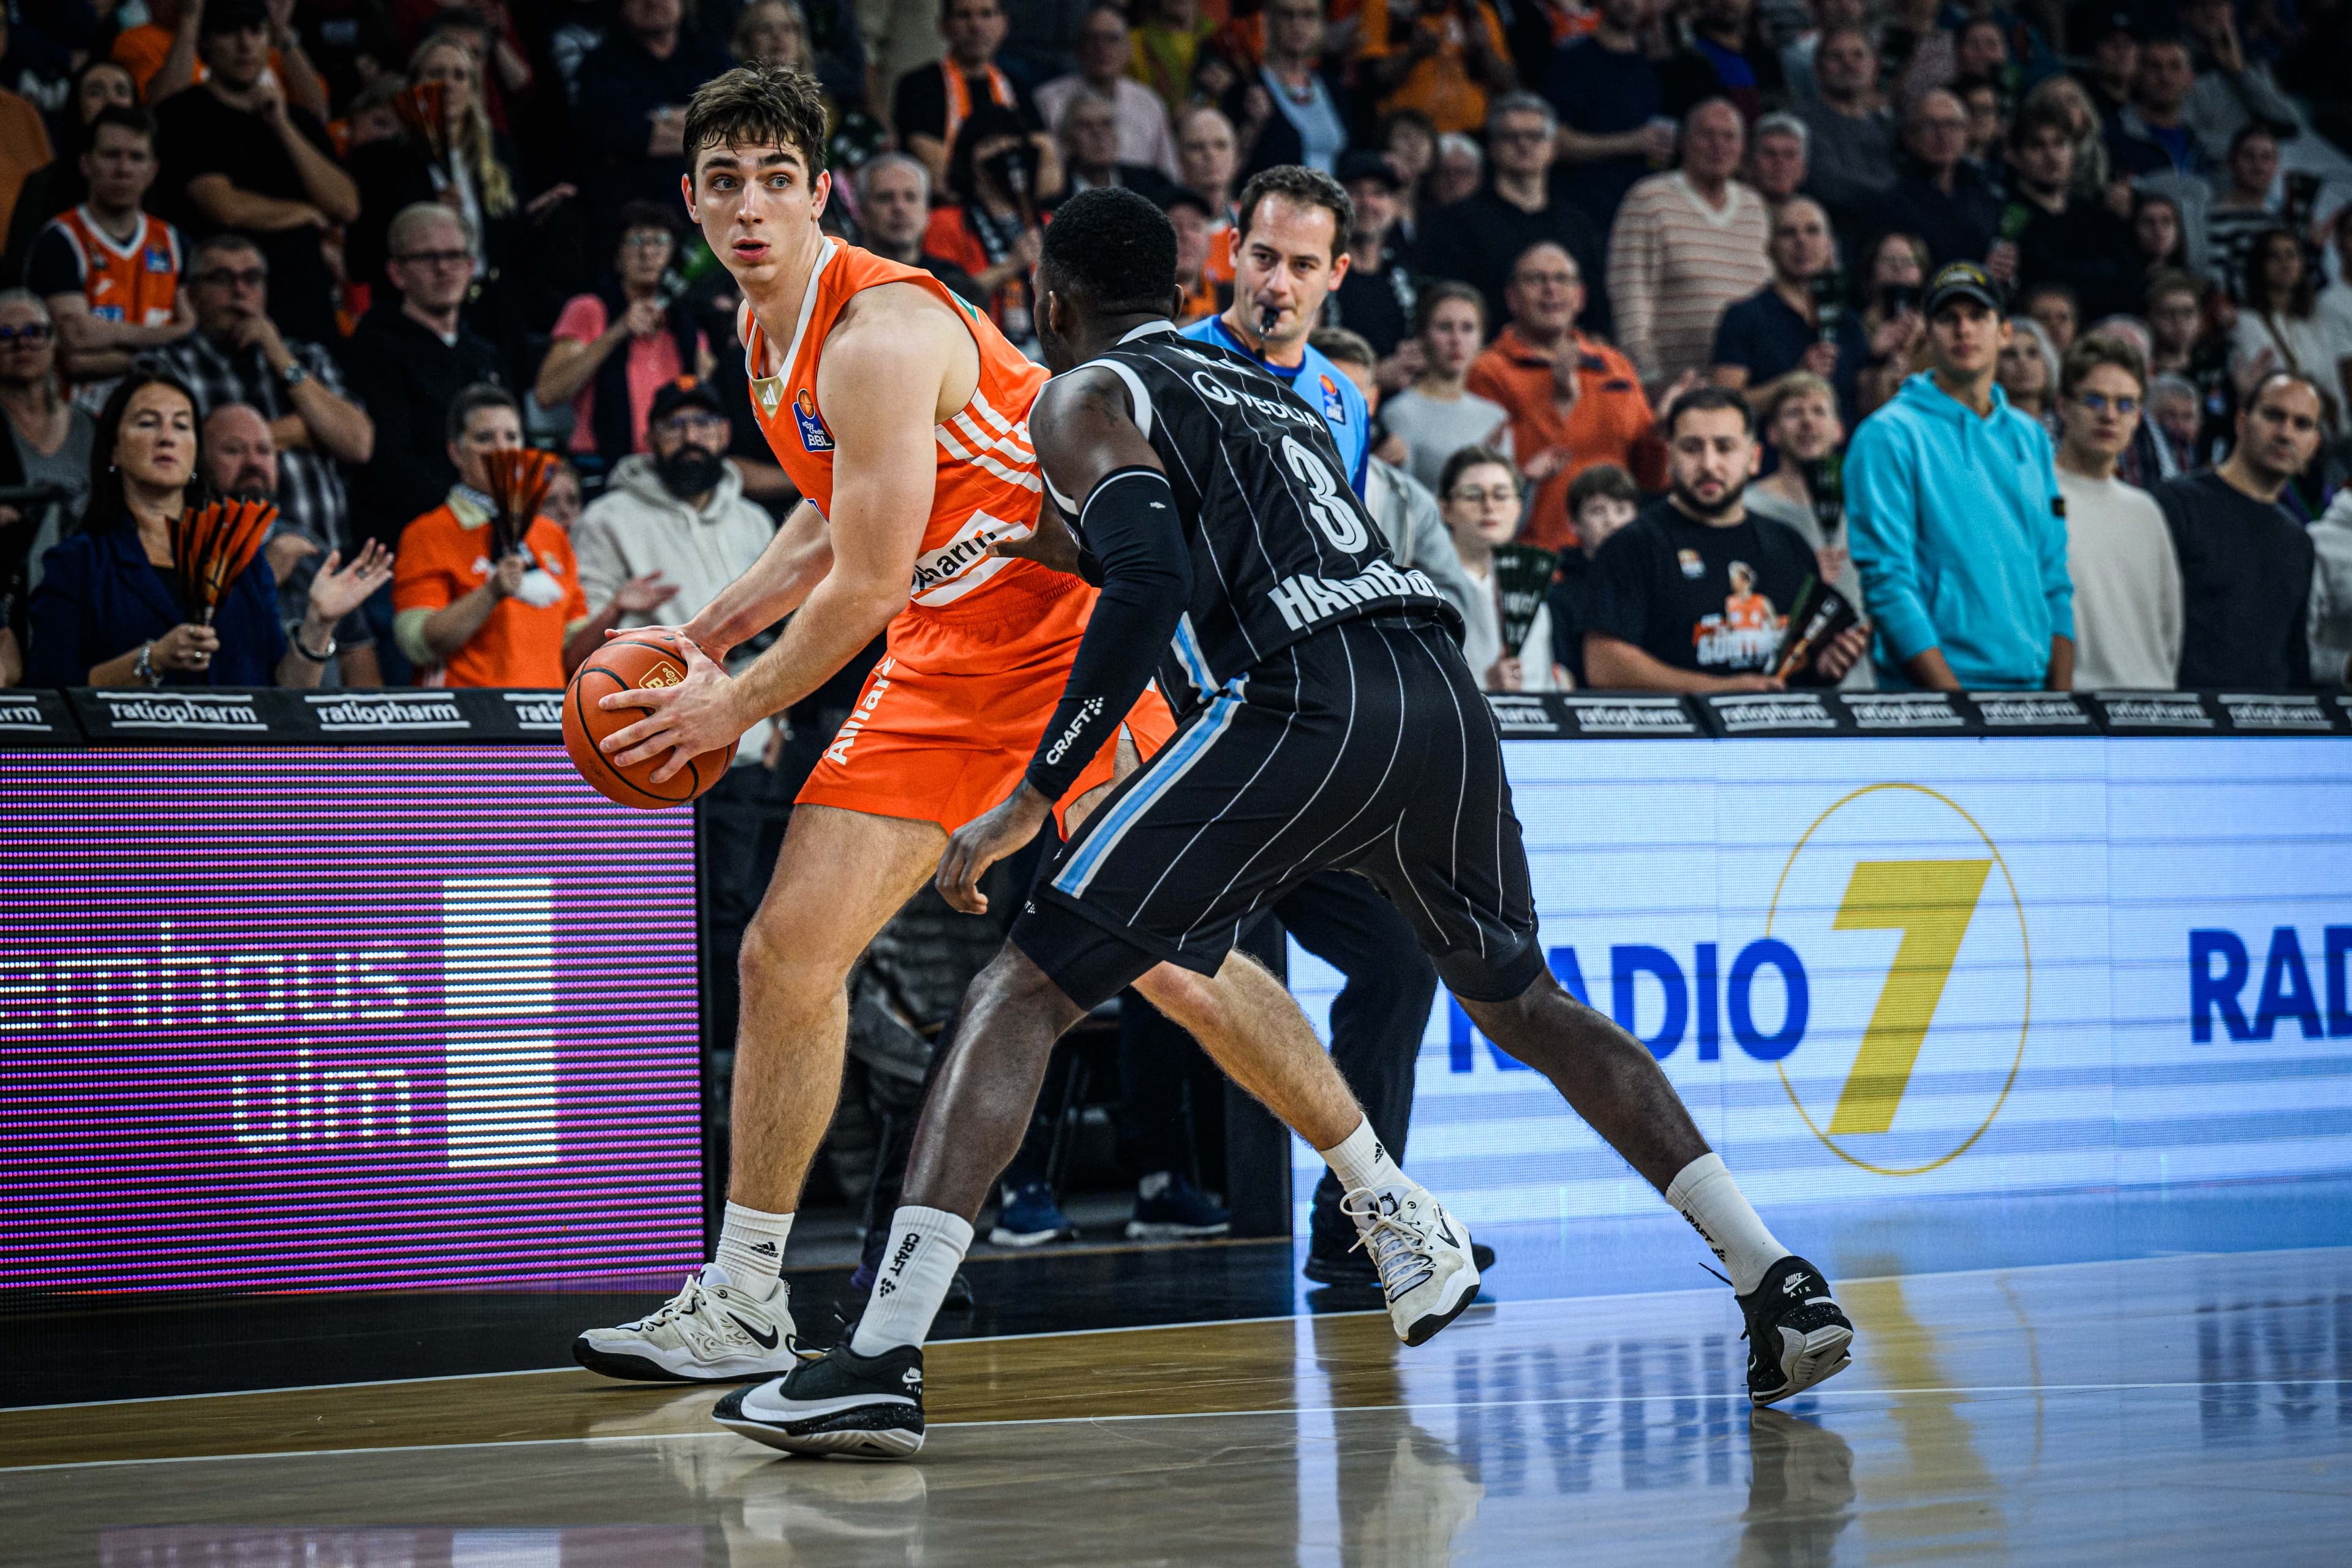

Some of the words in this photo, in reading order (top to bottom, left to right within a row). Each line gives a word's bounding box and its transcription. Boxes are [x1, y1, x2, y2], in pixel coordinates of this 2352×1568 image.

[807, 434, 832, 446] BBL
[1281, 435, 1368, 554] 3
[110, 699, 257, 723] ratiopharm
[317, 700, 460, 725] ratiopharm
[515, 701, 563, 722] rati
[1046, 707, 1091, 765] CRAFT
[1827, 859, 1994, 1135] 7
[232, 1036, 411, 1152] ulm
[1682, 1210, 1715, 1243] CRAFT
[750, 1246, 779, 1258] adidas
[889, 1233, 920, 1276] CRAFT
[1785, 1272, 1803, 1287] NIKE
[1790, 1286, 1811, 1298] AIR
